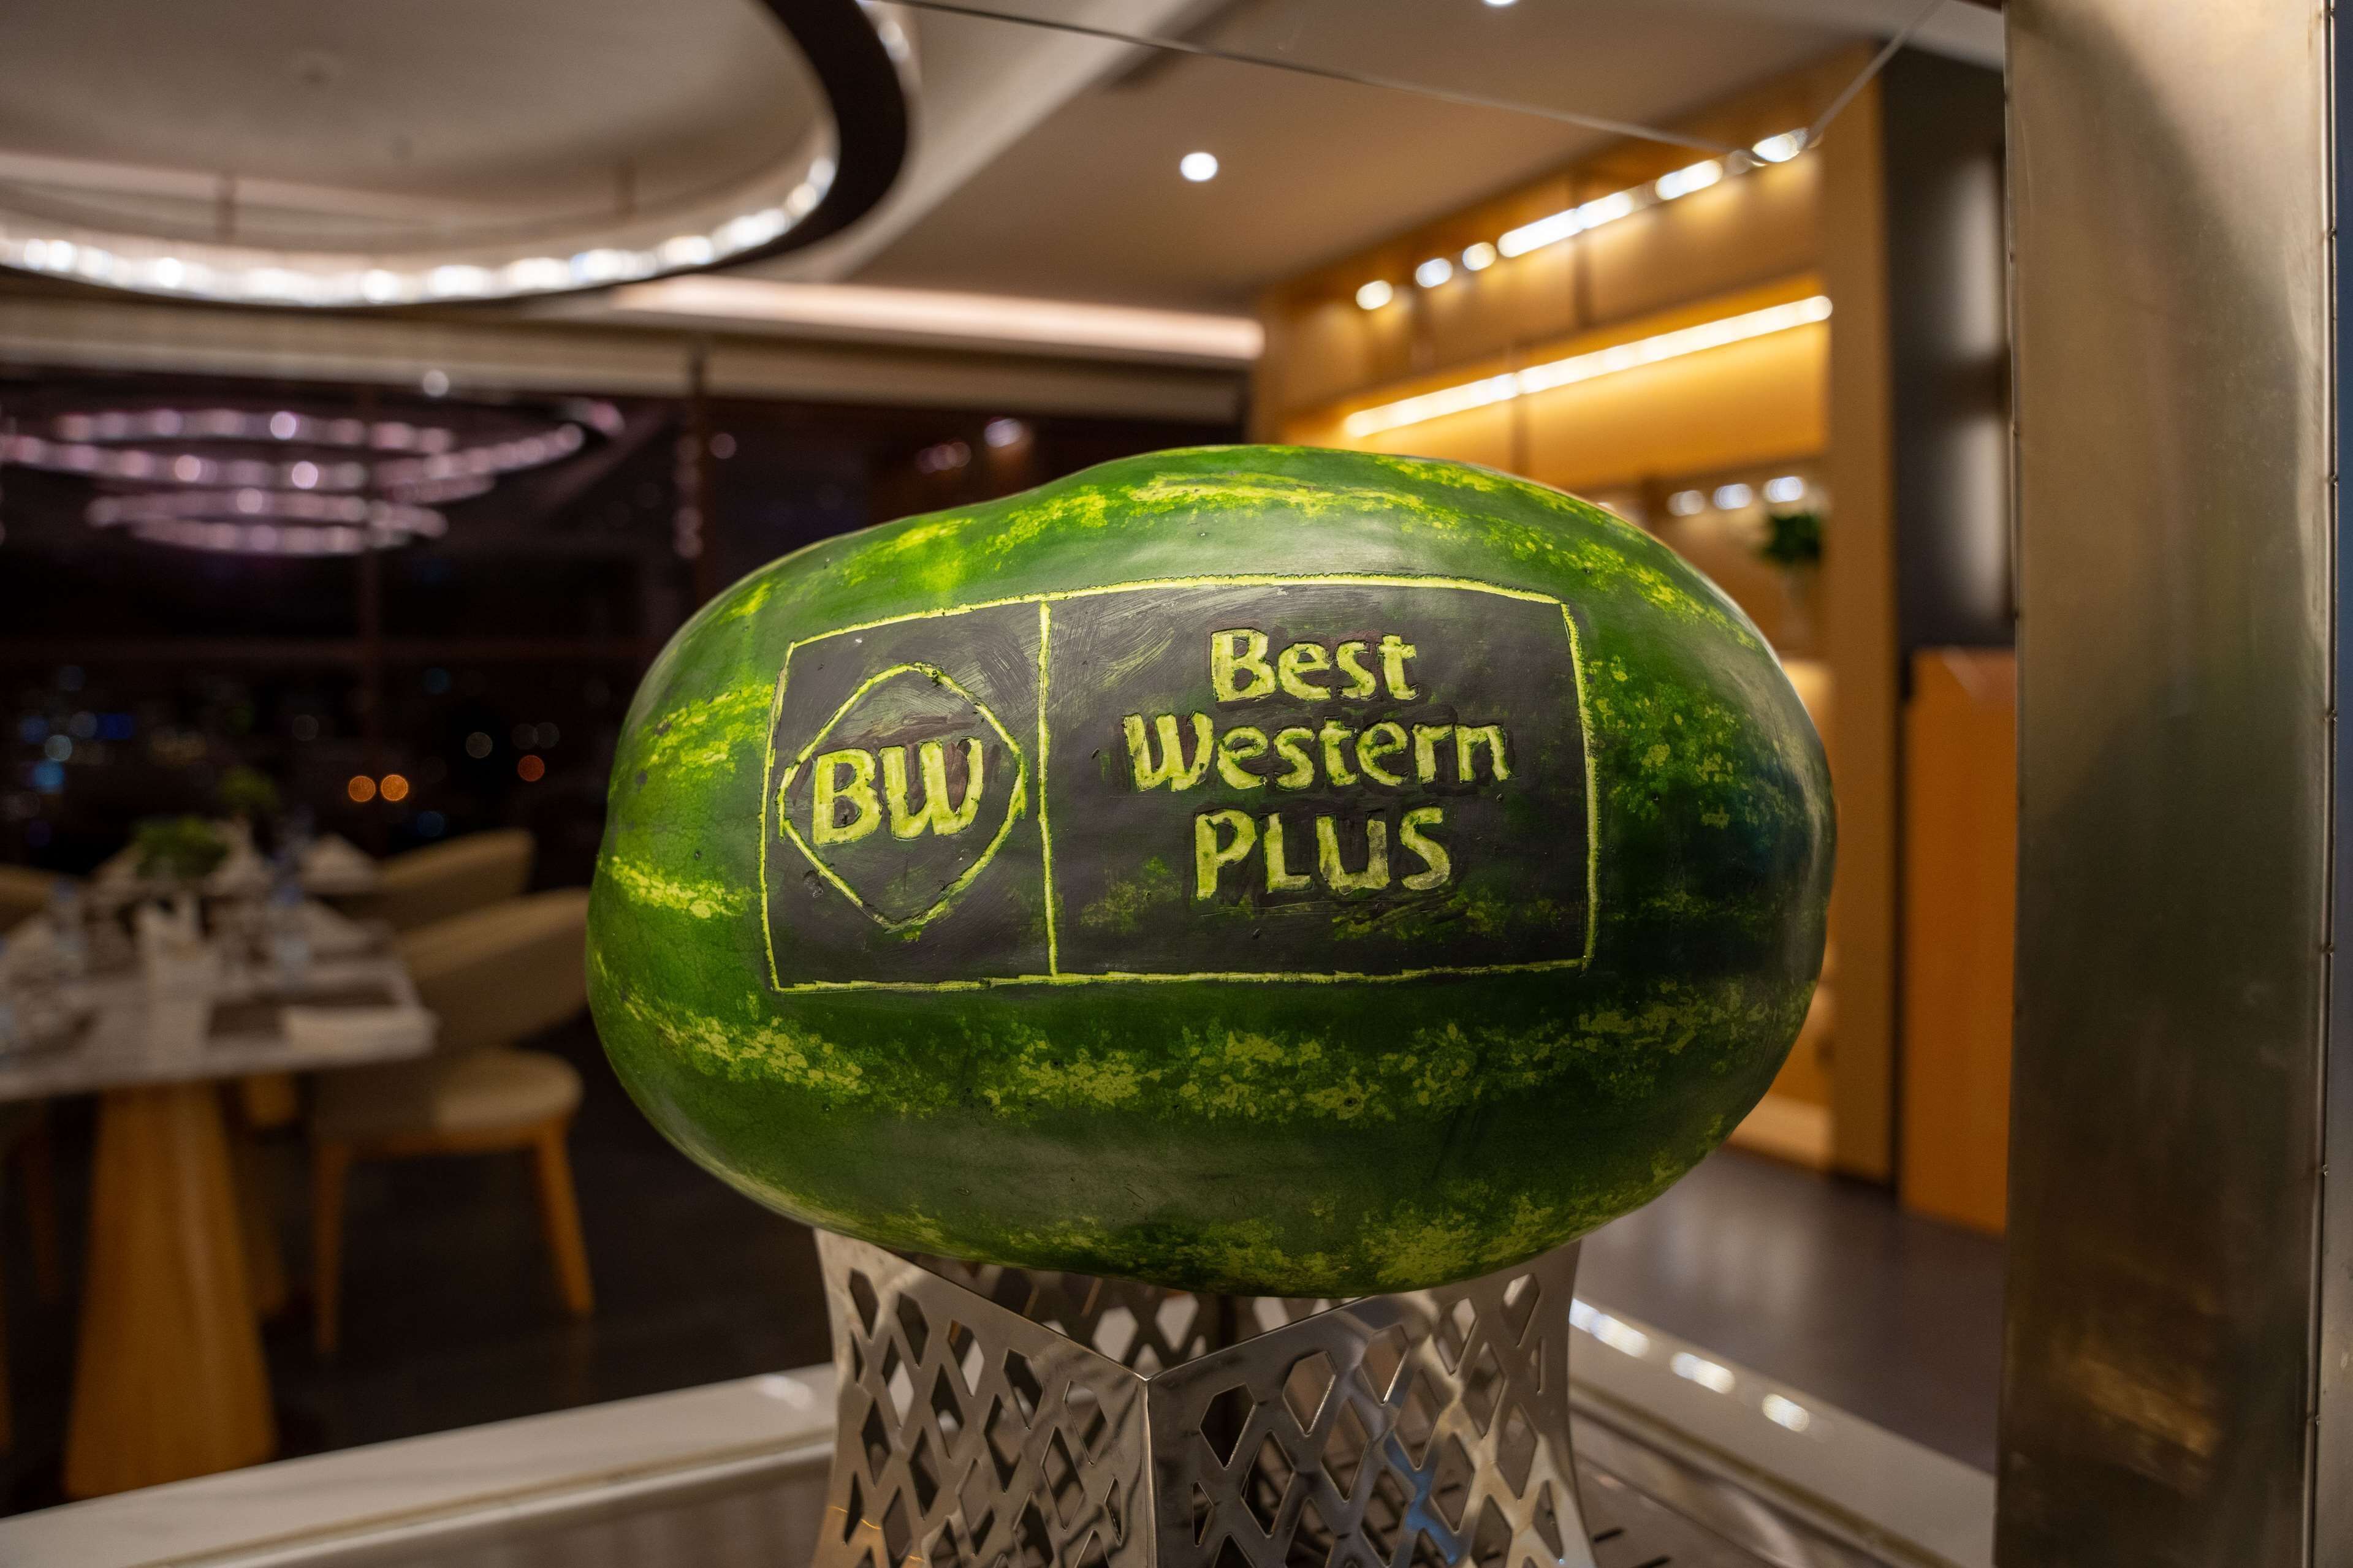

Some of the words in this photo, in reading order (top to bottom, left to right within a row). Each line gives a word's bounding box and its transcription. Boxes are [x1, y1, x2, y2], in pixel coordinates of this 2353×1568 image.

[1211, 627, 1418, 702] Best
[813, 737, 983, 846] BW
[1122, 711, 1512, 792] Western
[1195, 806, 1451, 900] PLUS
